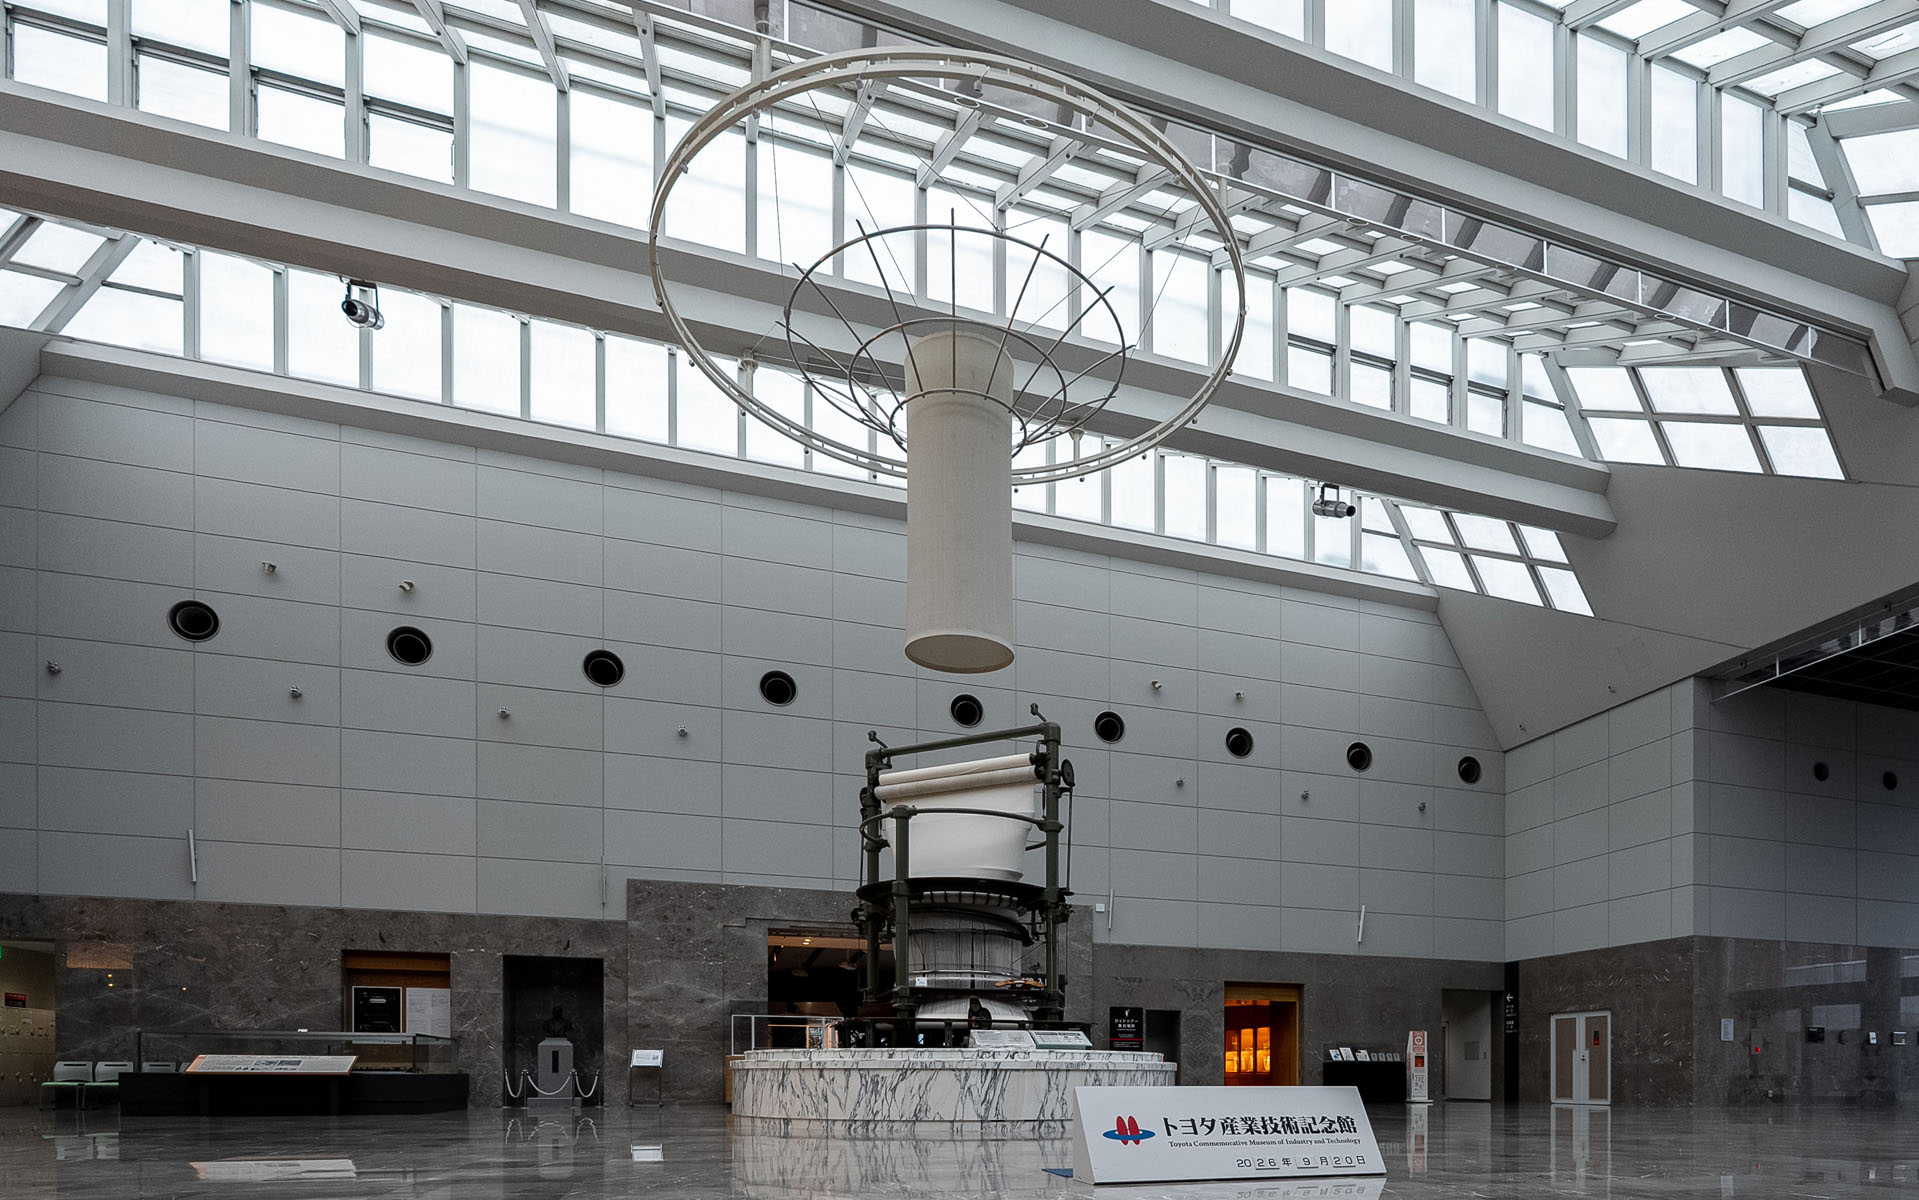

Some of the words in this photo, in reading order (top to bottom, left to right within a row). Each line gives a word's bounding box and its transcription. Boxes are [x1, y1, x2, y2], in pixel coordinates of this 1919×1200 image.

[1162, 1115, 1358, 1137] トヨタ産業技術記念館
[1168, 1140, 1193, 1149] Toyota
[1285, 1138, 1313, 1146] Industry
[1326, 1137, 1361, 1145] Technology
